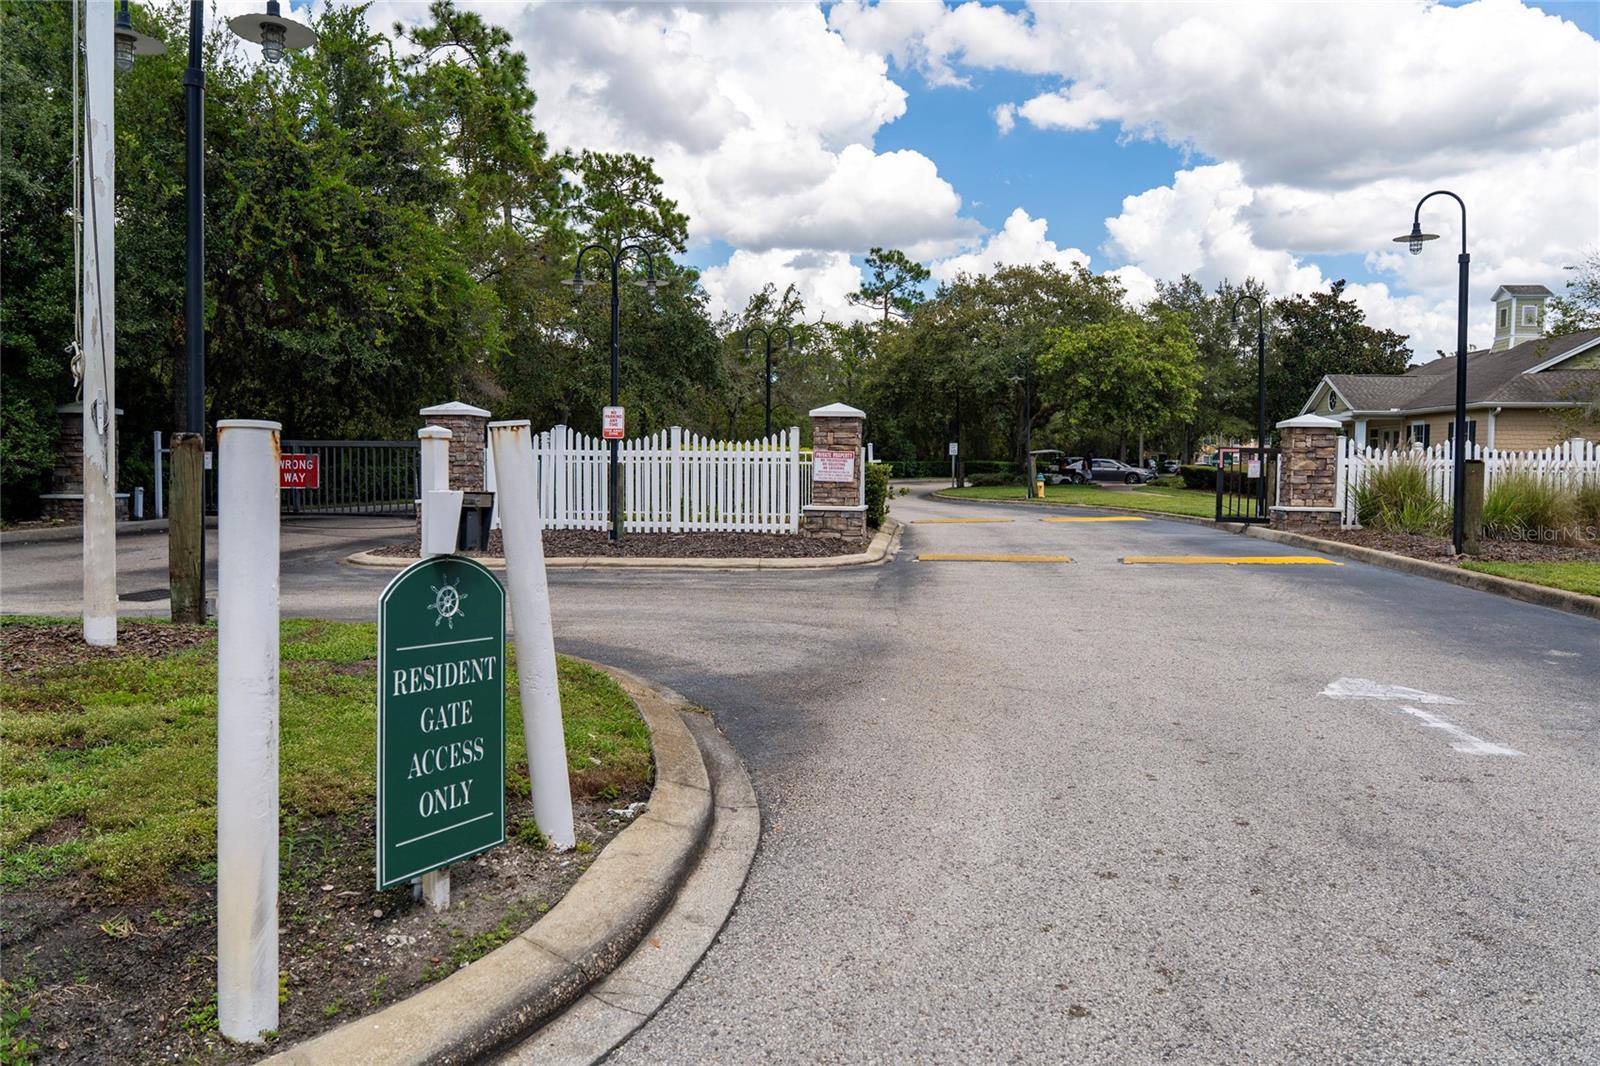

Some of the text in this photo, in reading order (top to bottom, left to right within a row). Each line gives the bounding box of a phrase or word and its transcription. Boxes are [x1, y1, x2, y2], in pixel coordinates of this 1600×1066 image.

[284, 473, 305, 482] WAY
[392, 656, 496, 696] RESIDENT
[420, 700, 472, 733] GATE
[408, 737, 484, 779] ACCESS
[419, 779, 473, 818] ONLY
